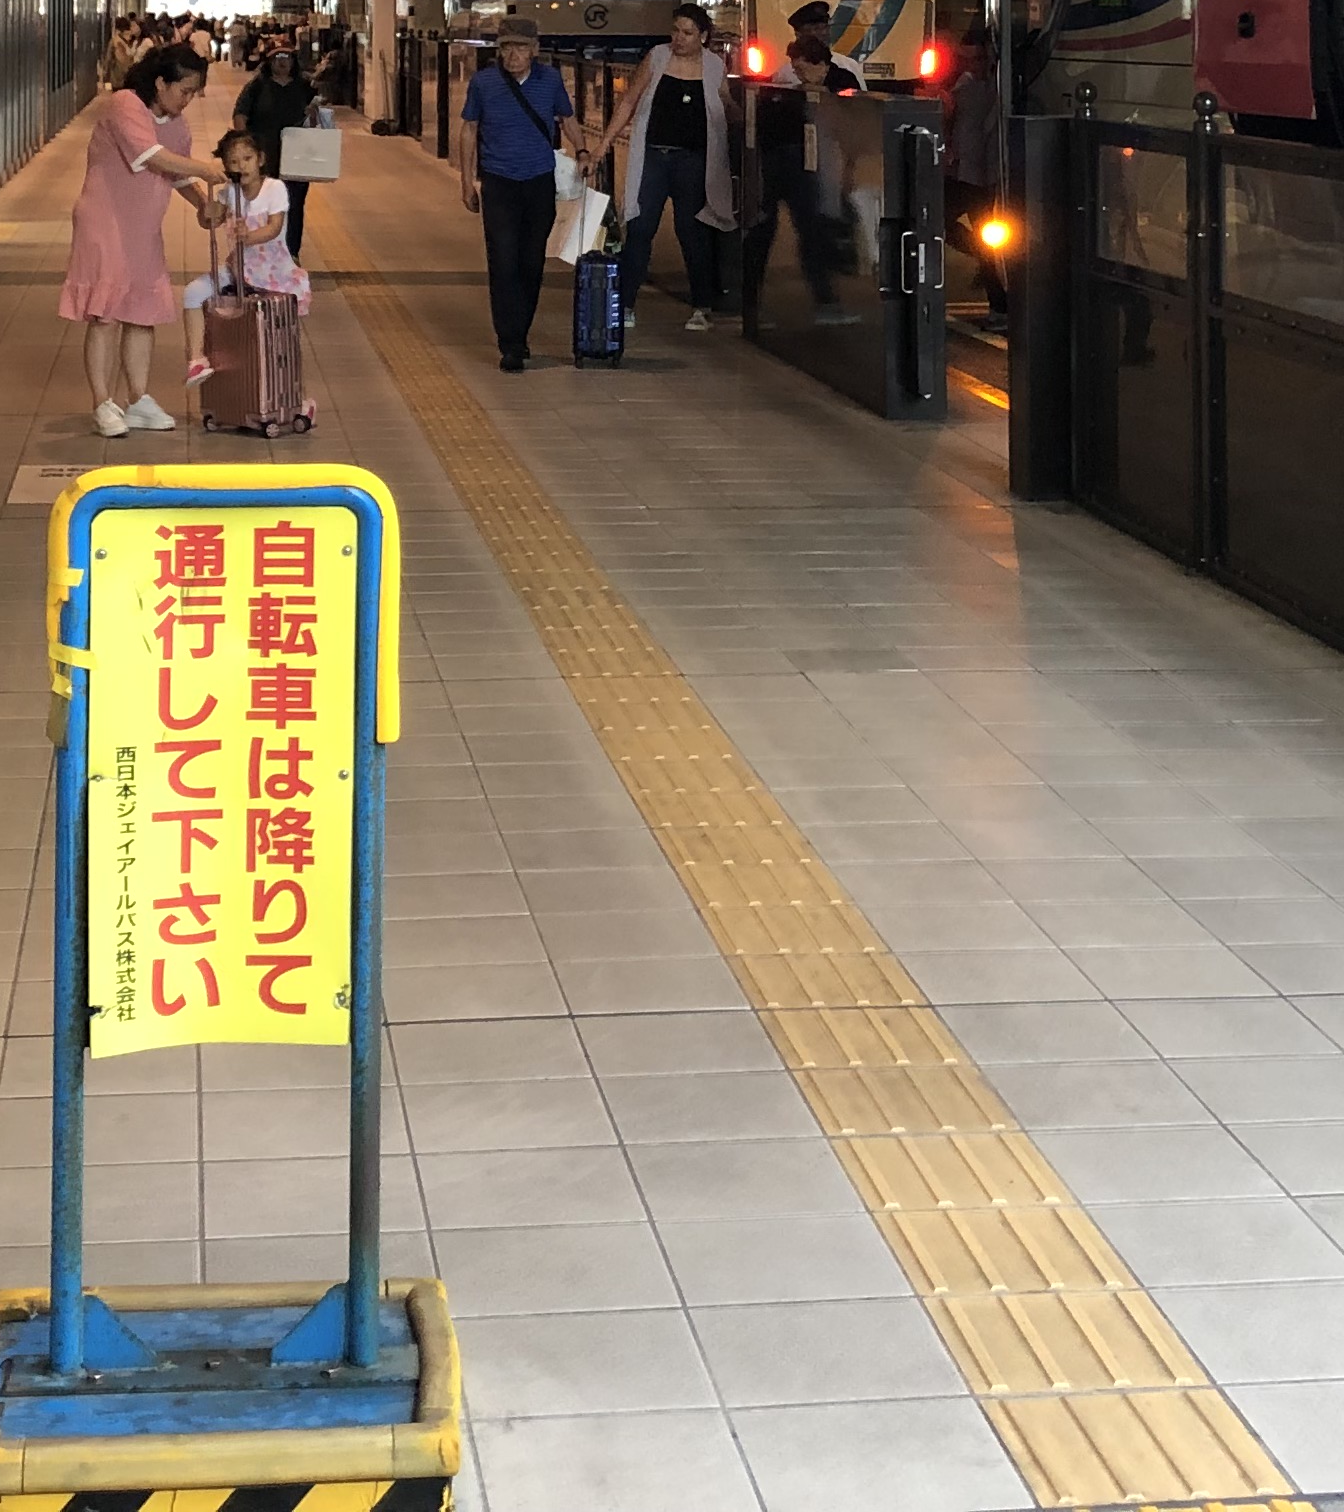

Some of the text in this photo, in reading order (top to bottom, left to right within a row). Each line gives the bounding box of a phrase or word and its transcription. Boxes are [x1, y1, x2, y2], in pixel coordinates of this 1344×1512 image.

[115, 745, 137, 1022] 西日本ジェイアールバス株式会社
[151, 523, 227, 1017] 通行して下さい
[245, 520, 318, 1016] 自転車は降りて
